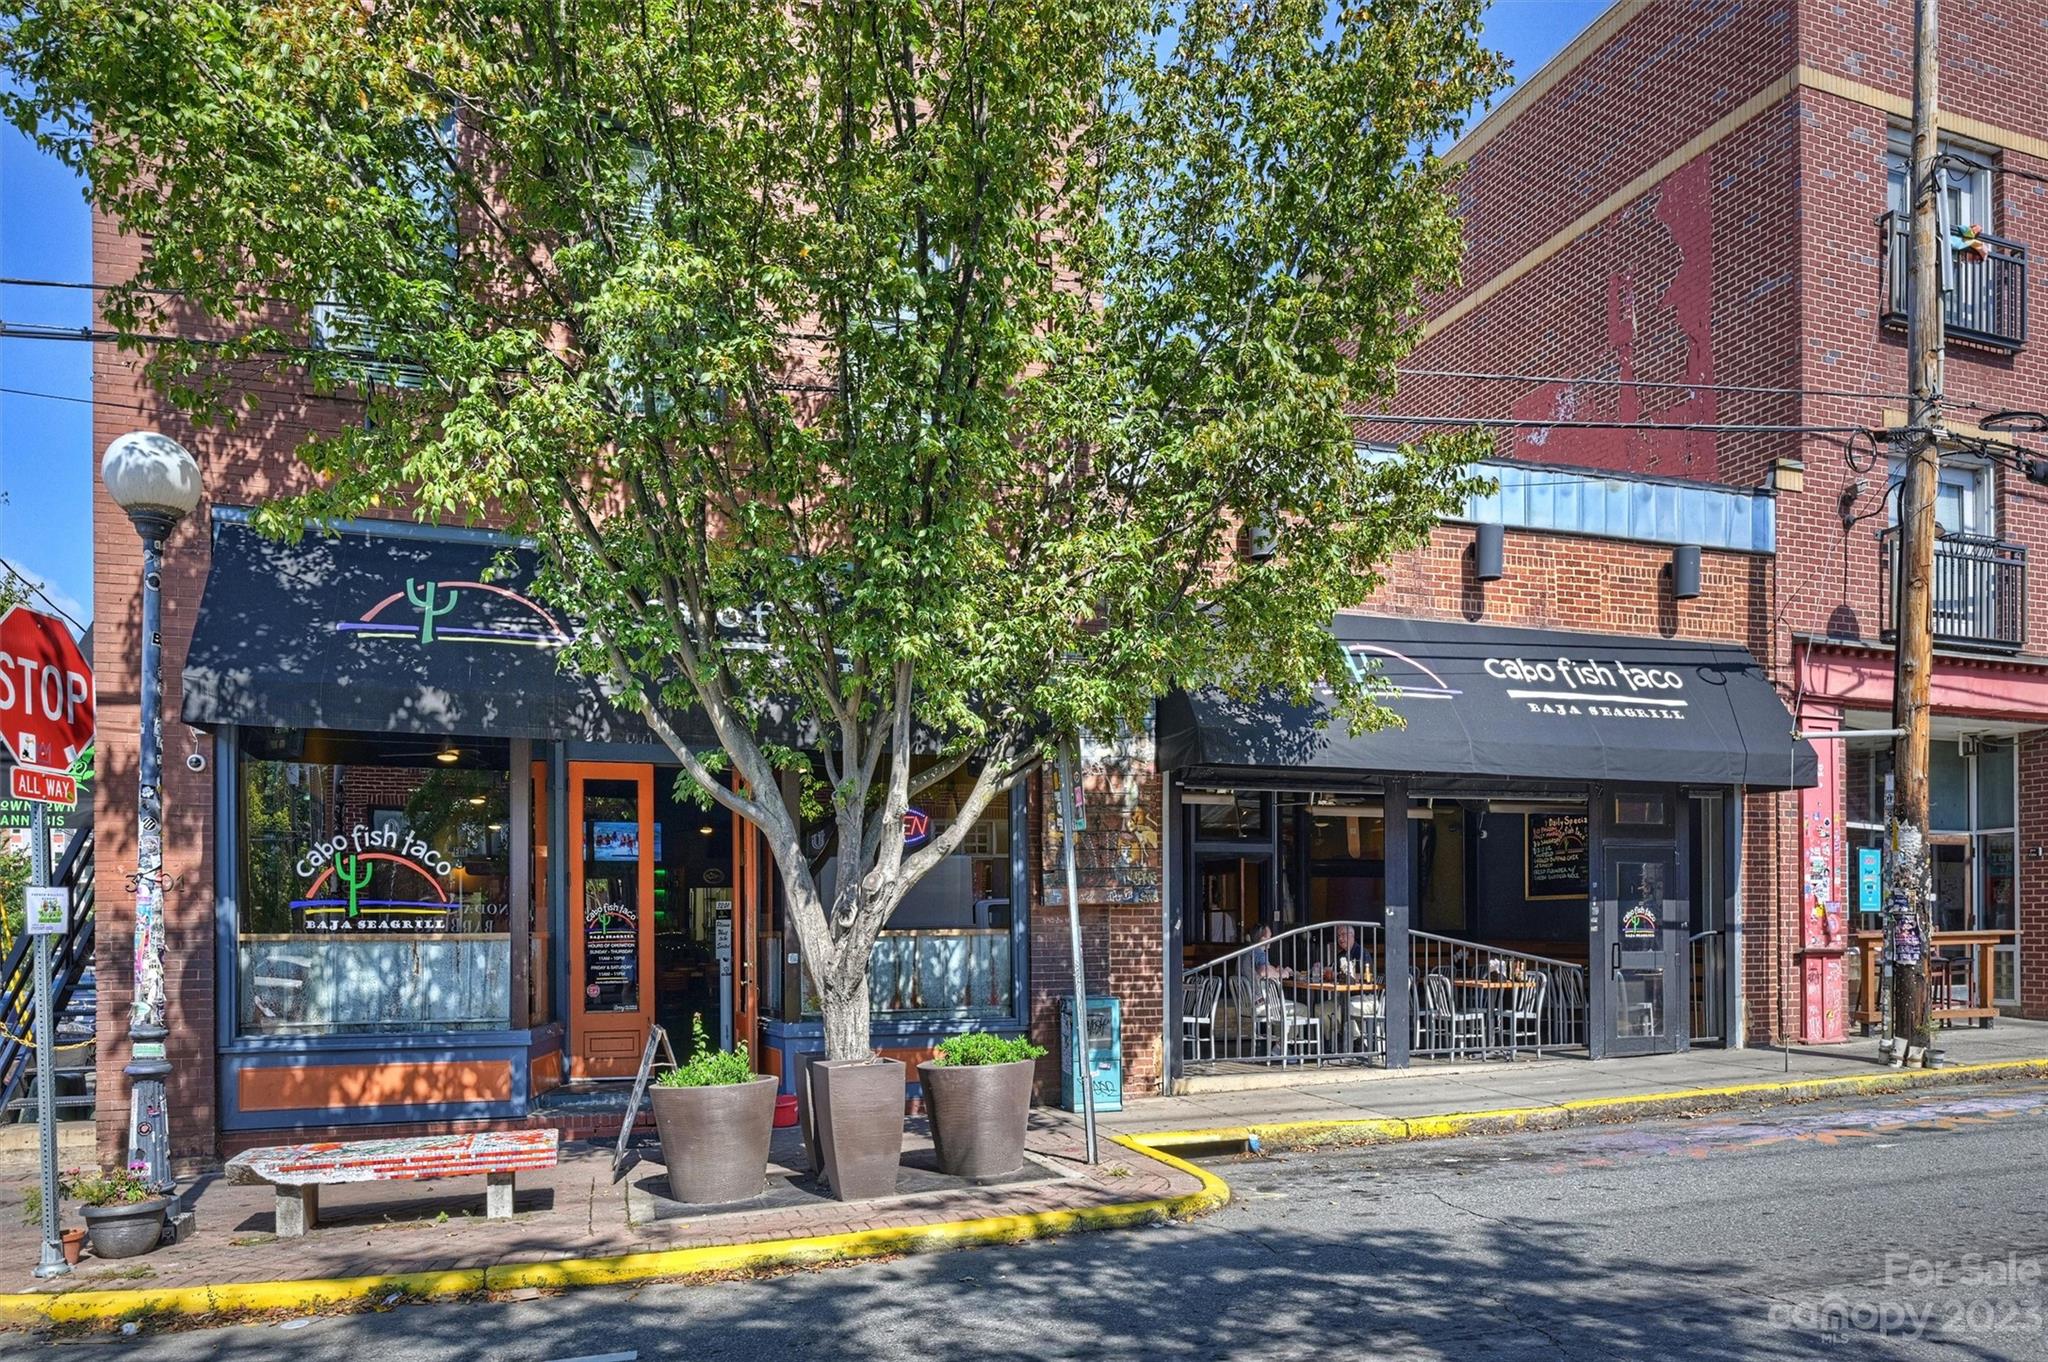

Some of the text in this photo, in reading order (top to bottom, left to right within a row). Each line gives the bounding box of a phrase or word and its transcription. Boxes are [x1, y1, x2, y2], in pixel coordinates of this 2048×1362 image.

[1557, 657, 1617, 689] fish
[1614, 660, 1684, 691] taco
[0, 651, 88, 725] STOP
[1527, 702, 1685, 719] BAJA SEAGRILL
[18, 774, 70, 799] ALL WAY
[0, 800, 77, 812] OWNWN
[0, 814, 65, 826] ANNIS
[902, 815, 929, 836] EN
[351, 823, 398, 852] fish
[401, 829, 452, 876] taco
[125, 873, 185, 893] 301
[305, 920, 446, 931] BAJA SEAGRILL
